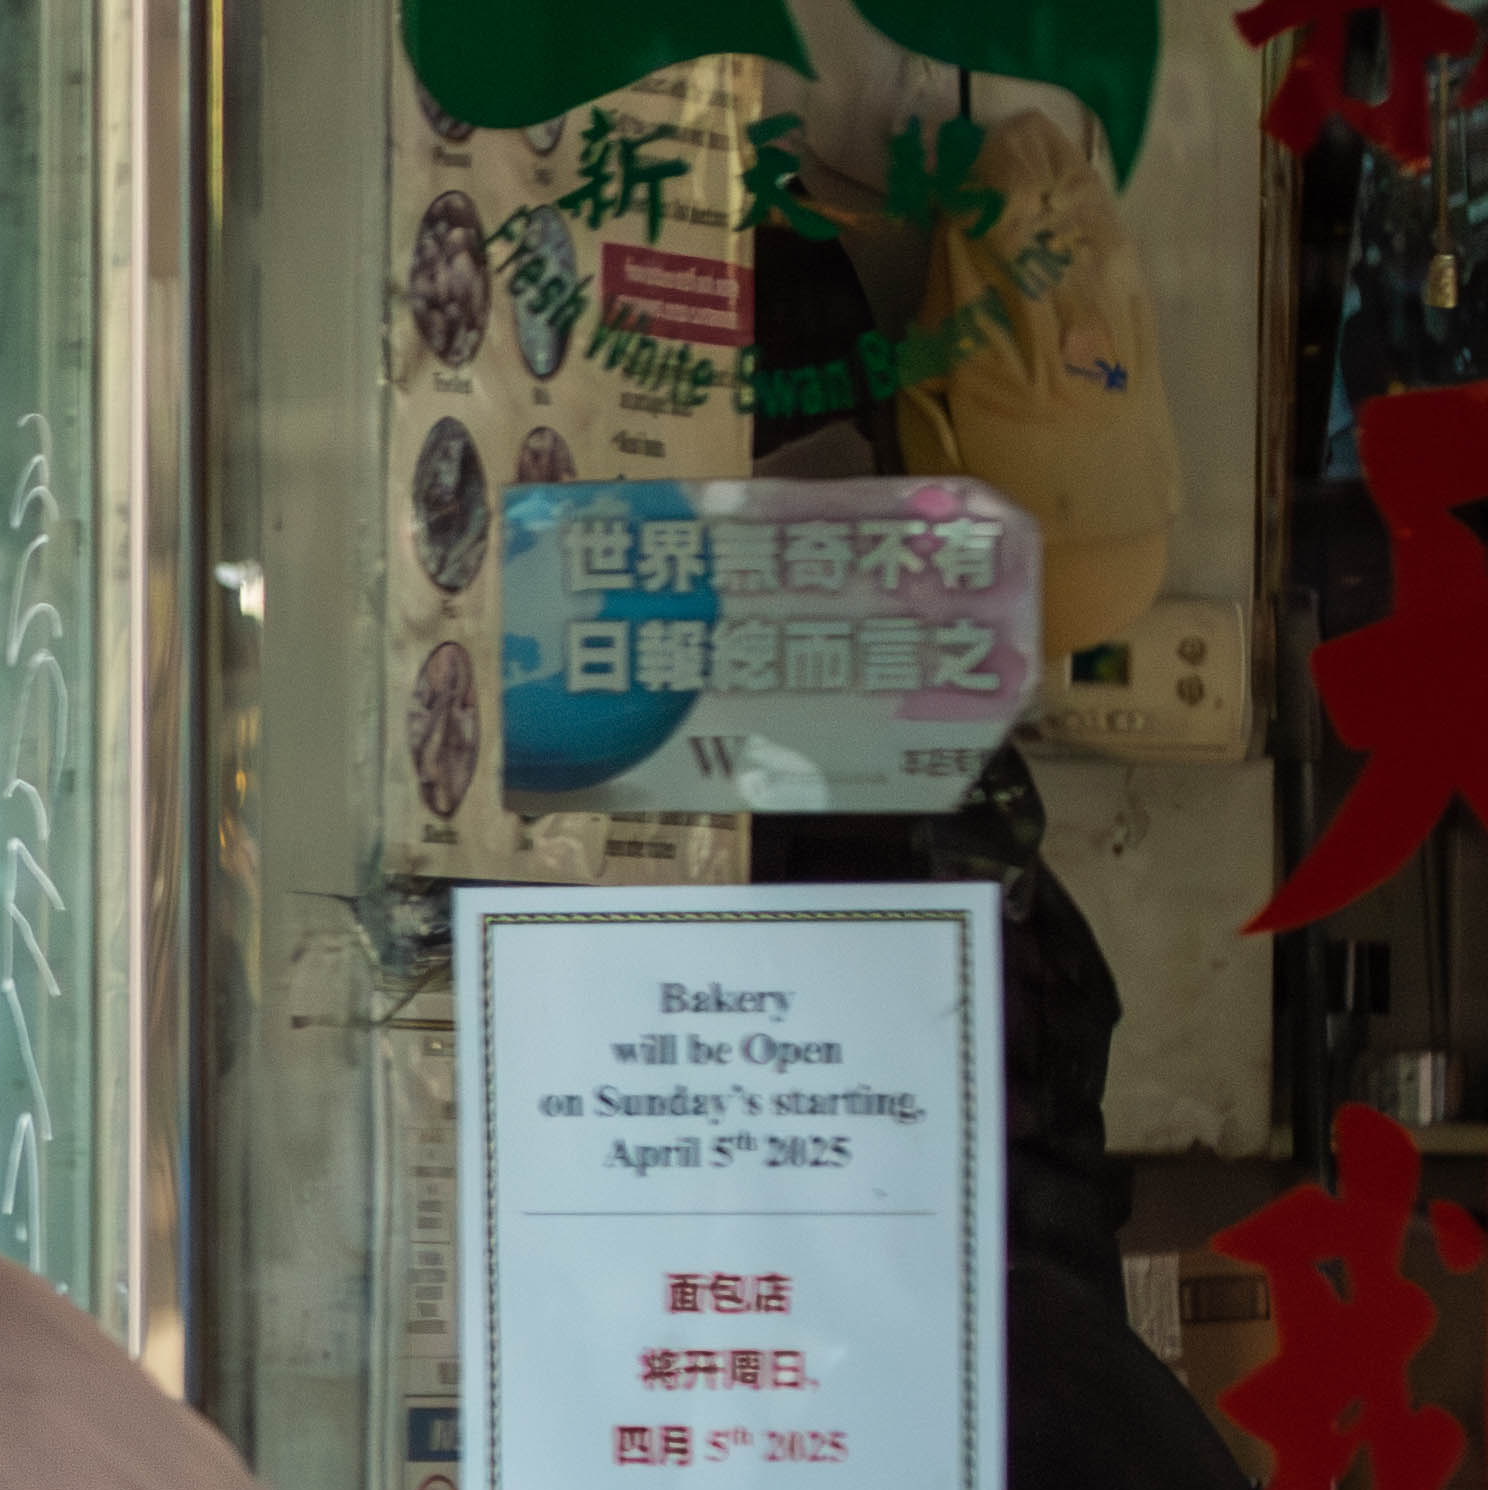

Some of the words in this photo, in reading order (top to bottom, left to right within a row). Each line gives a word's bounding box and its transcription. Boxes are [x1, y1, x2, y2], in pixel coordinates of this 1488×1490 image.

[483, 203, 595, 332] Fresh
[584, 297, 716, 406] White
[562, 516, 1004, 592] 世界無奇不有
[659, 980, 796, 1023] Bakery
[609, 1034, 679, 1067] will
[687, 1034, 734, 1067] be
[740, 1032, 844, 1074] Open
[537, 1091, 584, 1119] on
[594, 1085, 762, 1126] Sunday's
[603, 1136, 703, 1177] April
[710, 1130, 759, 1168] 5th
[765, 1134, 853, 1170] 2025
[664, 1272, 792, 1316] 面包店
[614, 1424, 694, 1467] 四月
[705, 1427, 753, 1462] 5th
[763, 1430, 849, 1462] 2025
